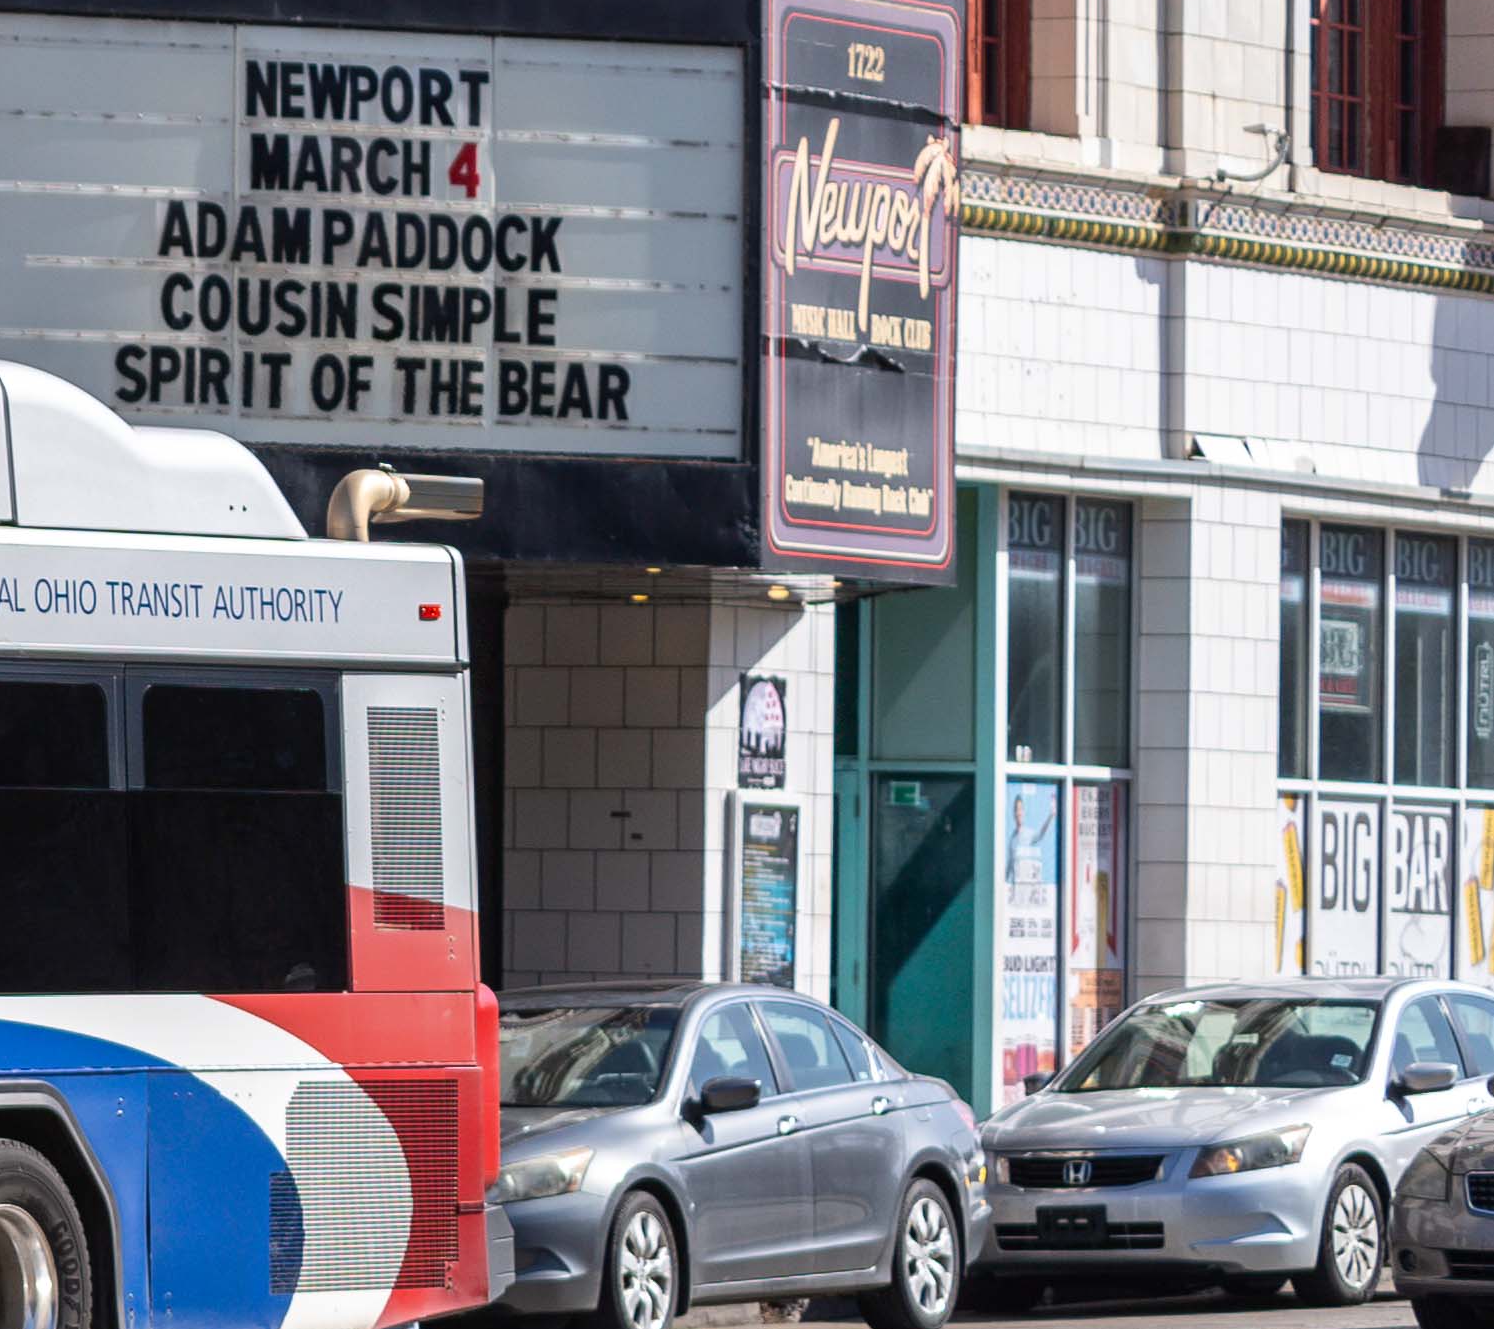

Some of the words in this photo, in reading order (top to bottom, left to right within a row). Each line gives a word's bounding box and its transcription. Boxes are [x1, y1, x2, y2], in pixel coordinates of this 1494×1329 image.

[245, 60, 491, 127] NEWPORT
[847, 41, 885, 82] 1722
[250, 133, 431, 197] MARCH
[448, 142, 481, 199] 4
[158, 200, 311, 265] ADAM
[322, 209, 563, 273] PADDOCK
[786, 117, 960, 333] Newport
[160, 272, 357, 339] COUSIN
[371, 282, 558, 346] SIMPLE
[115, 344, 292, 409] SPIRIT
[310, 352, 374, 412] OF
[395, 356, 485, 416] THE
[498, 359, 632, 421] BEAR
[1321, 531, 1366, 576] BIG
[1396, 538, 1441, 582] BIG
[1469, 545, 1494, 588] BI
[34, 578, 97, 615] OHIO
[105, 580, 203, 619] TRANSIT
[213, 585, 344, 623] AUTHORITY
[1320, 810, 1371, 913] BIG
[1392, 814, 1449, 912] BAR
